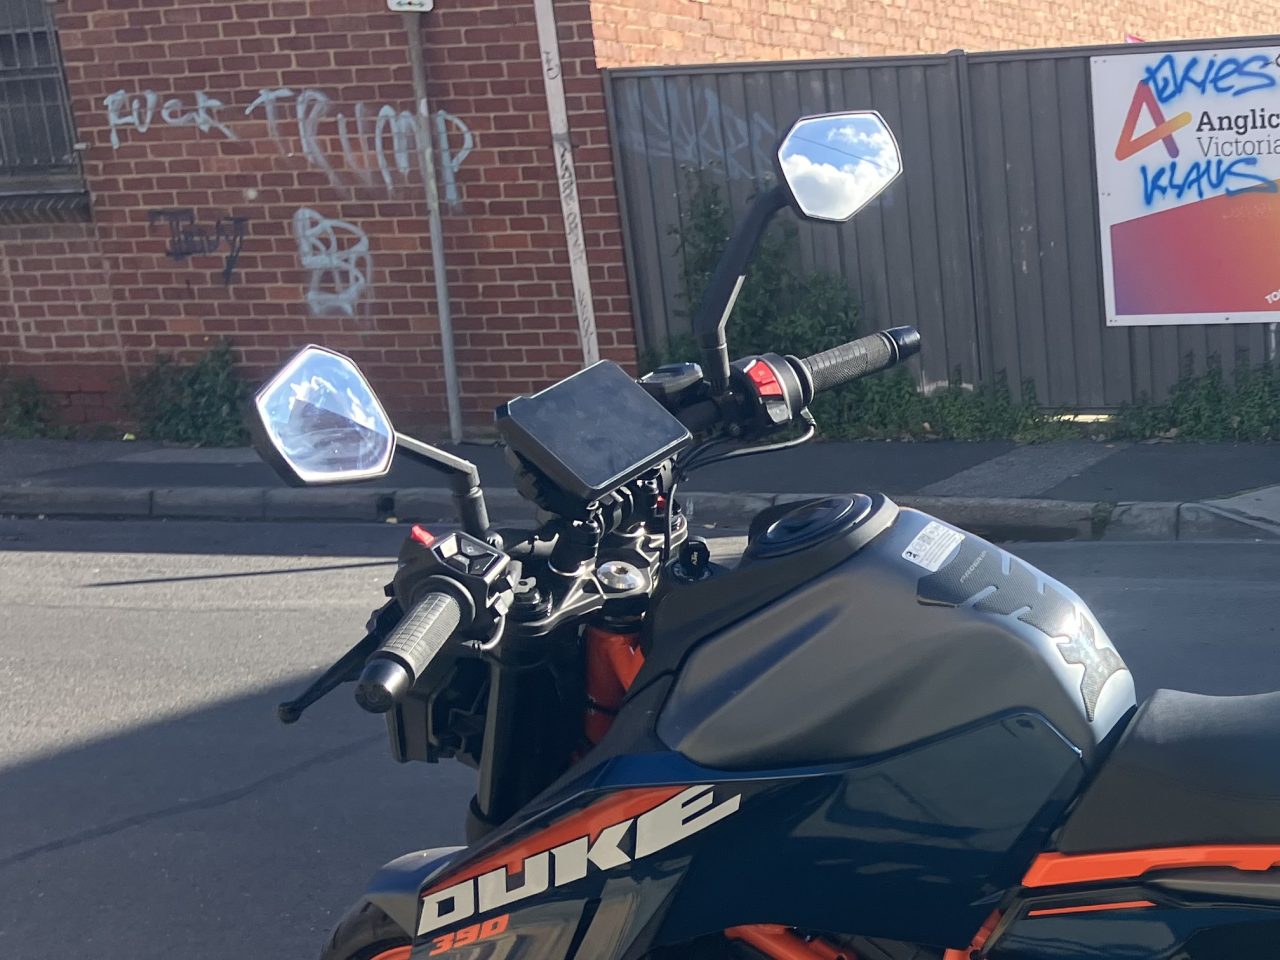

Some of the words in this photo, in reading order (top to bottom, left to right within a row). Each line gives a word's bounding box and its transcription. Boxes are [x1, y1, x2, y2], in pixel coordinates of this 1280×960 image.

[244, 87, 475, 207] TRUMP
[416, 784, 742, 936] DUKE
[429, 913, 509, 957] 390
